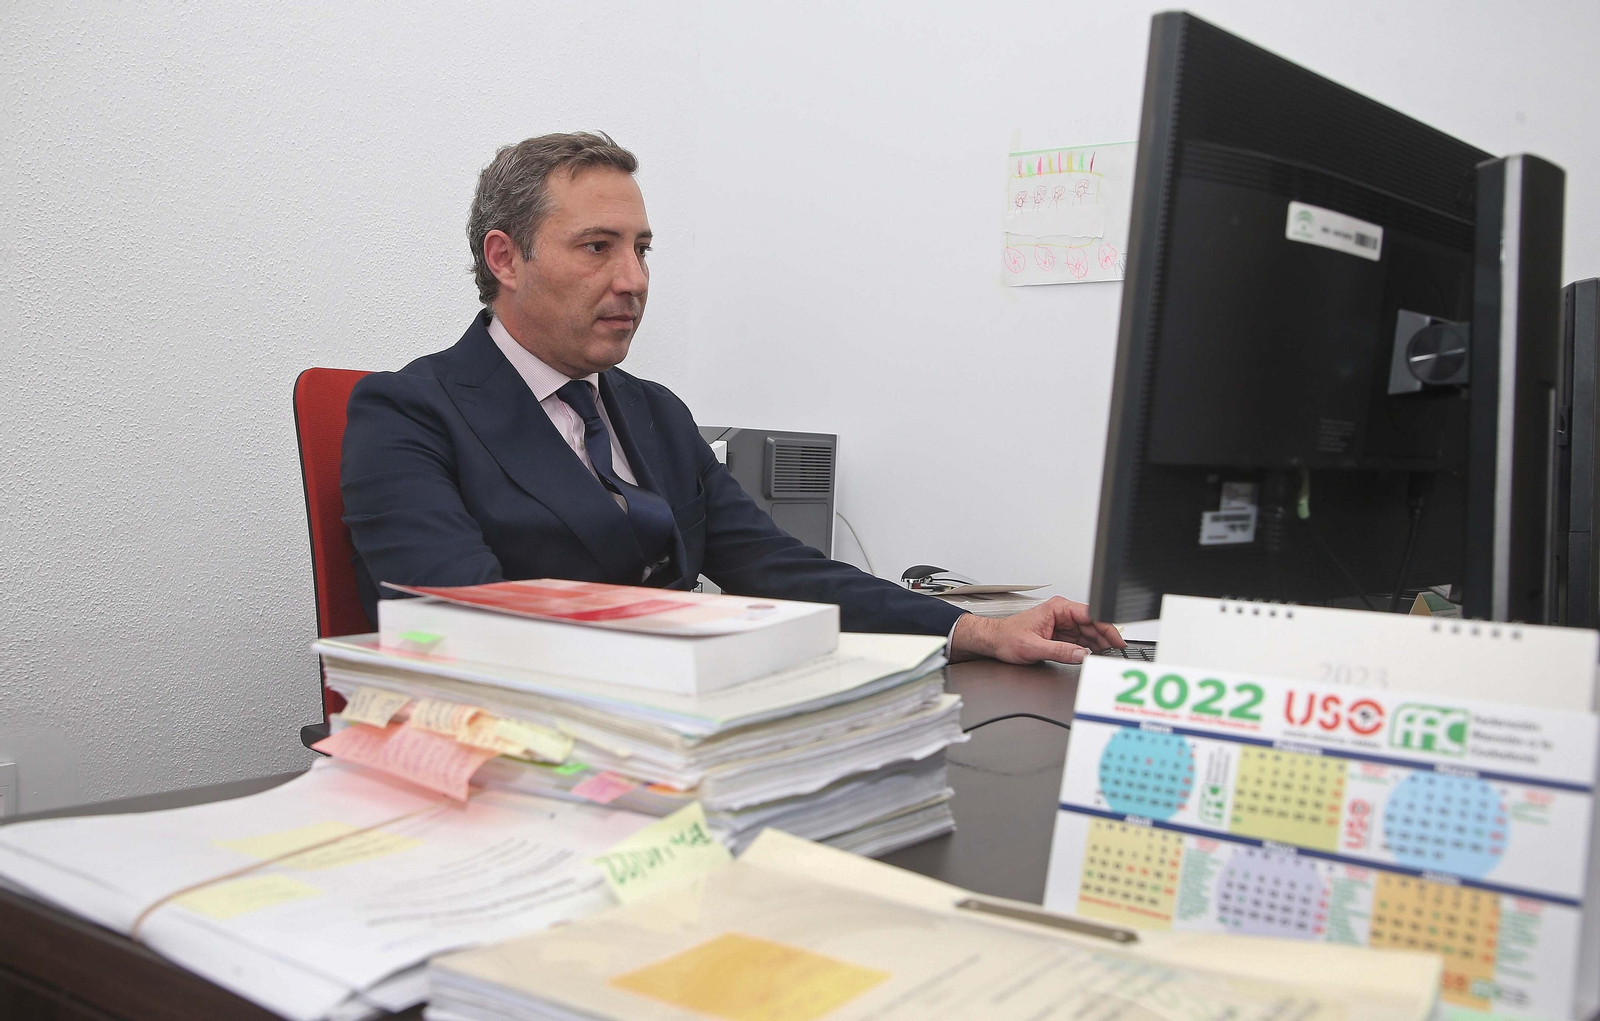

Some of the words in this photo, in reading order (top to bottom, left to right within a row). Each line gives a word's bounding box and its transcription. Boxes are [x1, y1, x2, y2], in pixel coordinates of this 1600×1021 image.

[1115, 669, 1265, 721] 2022
[1318, 663, 1389, 688] 2023
[1284, 691, 1384, 735] USO
